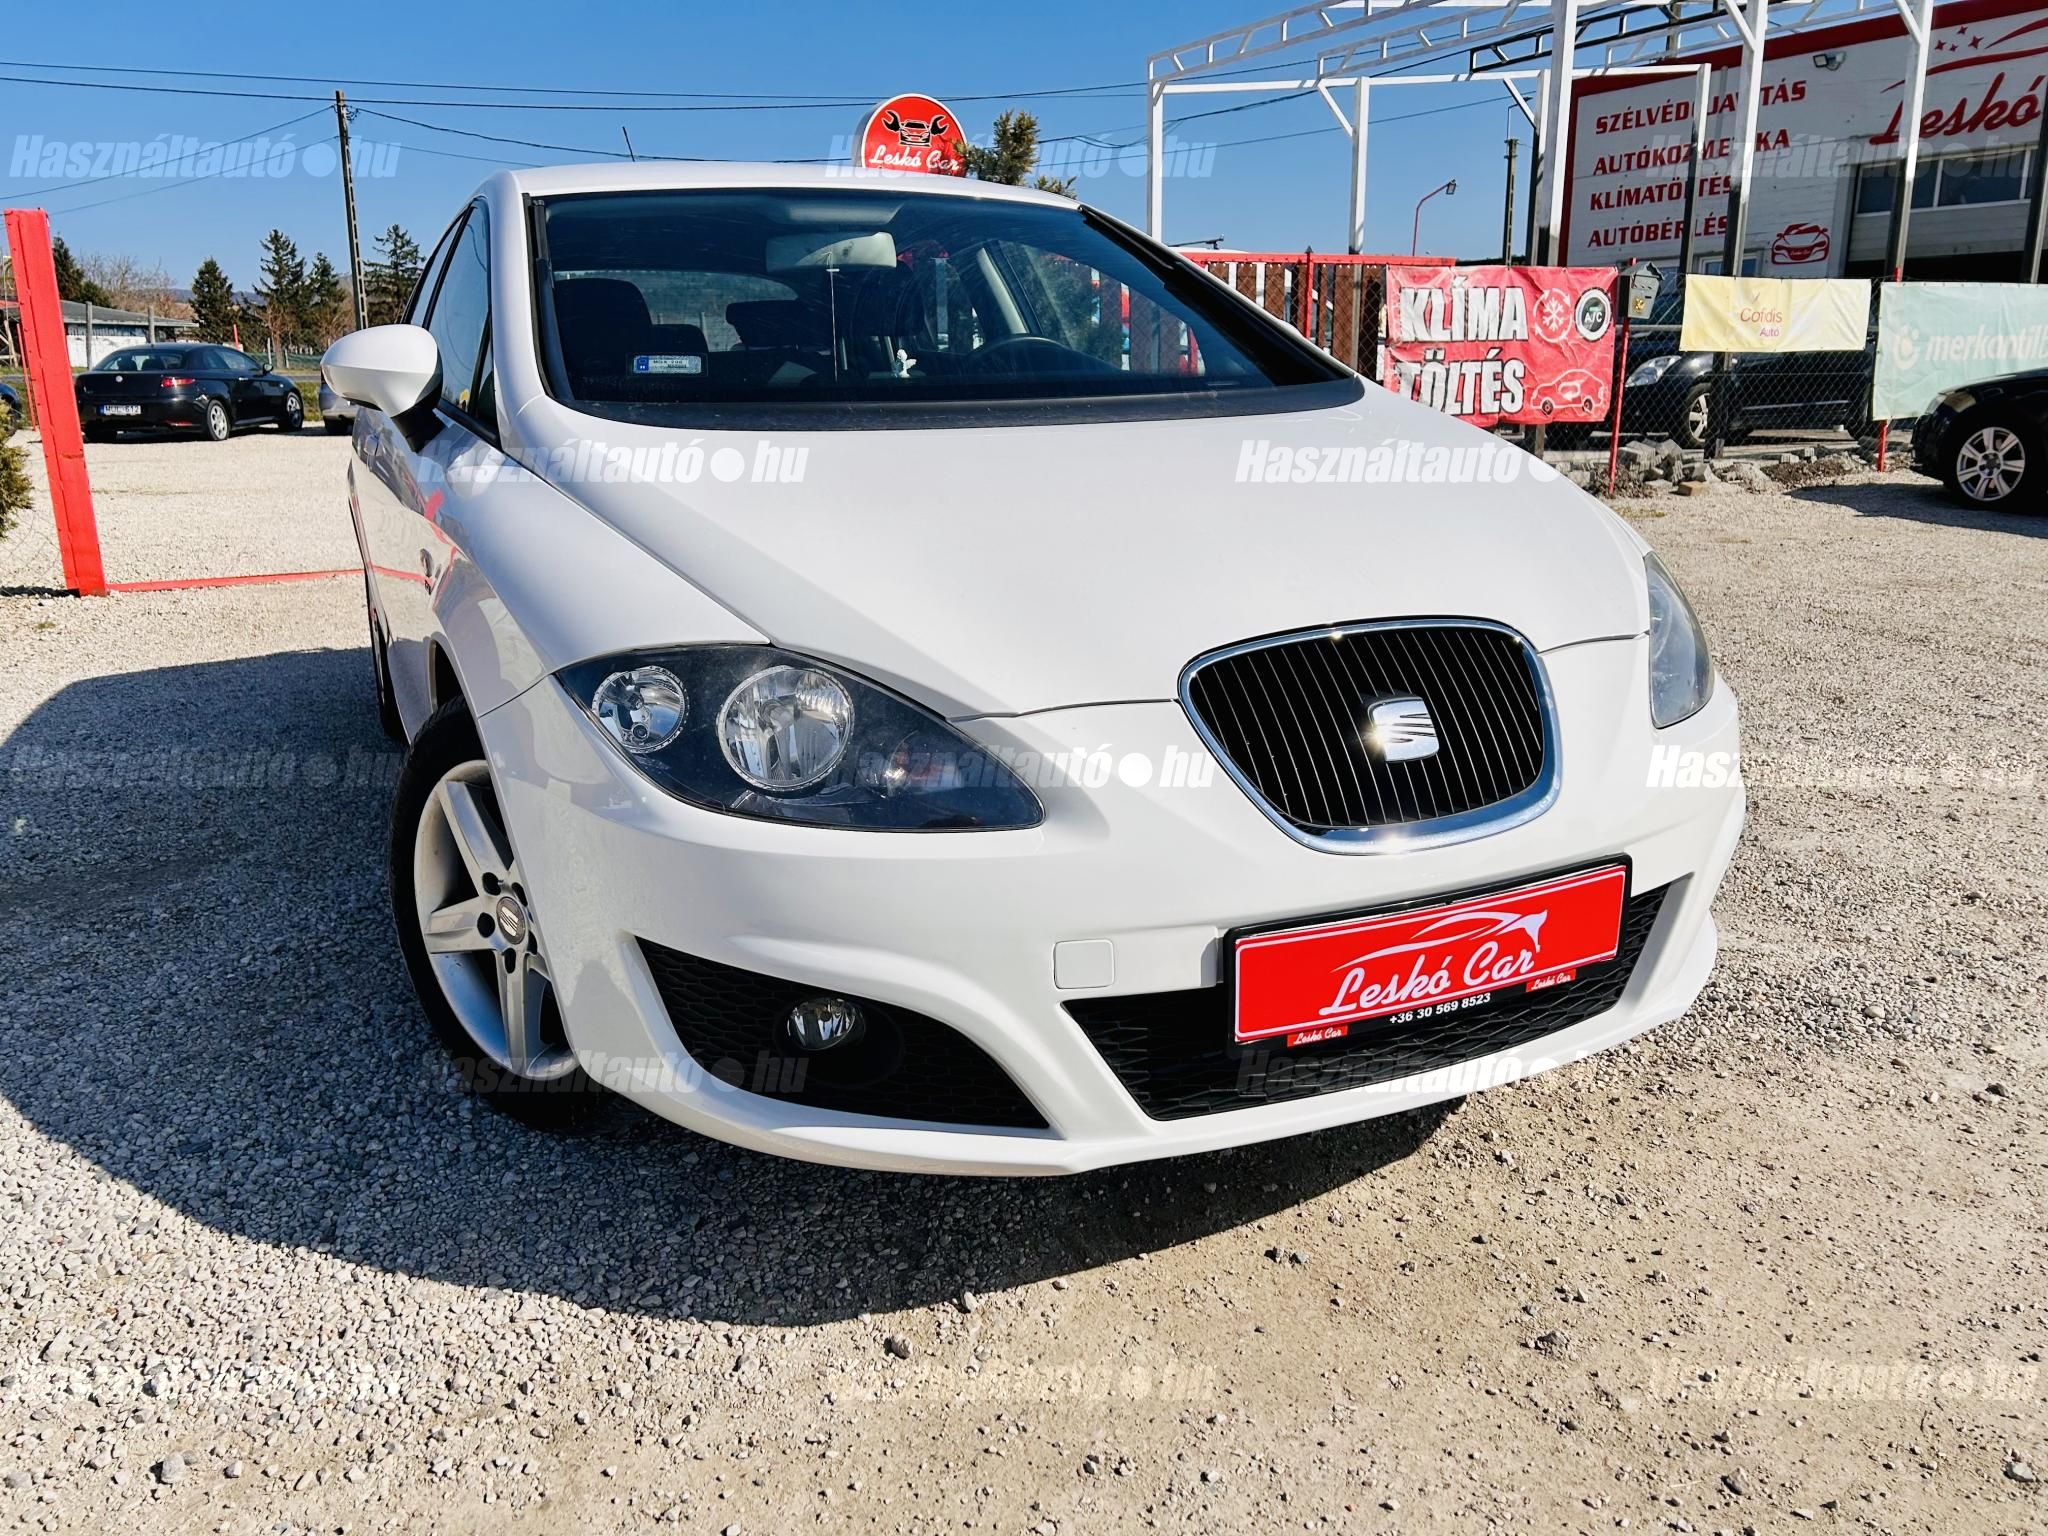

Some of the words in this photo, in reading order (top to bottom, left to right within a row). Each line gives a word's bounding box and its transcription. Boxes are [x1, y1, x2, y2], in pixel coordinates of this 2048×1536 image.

[869, 144, 922, 167] Leskó
[926, 149, 960, 171] Car
[1593, 128, 1790, 176] AUTÓKOZMEKA
[1400, 275, 1529, 342] KLÍMA
[1584, 311, 1603, 323] A/C
[1740, 306, 1783, 323] Cofidis
[1759, 327, 1780, 337] Autó
[1396, 347, 1526, 415] TÖLTÉS
[1319, 954, 1453, 1016] Leskó
[1463, 941, 1534, 986] Car
[1530, 977, 1556, 990] Leskó
[1556, 973, 1573, 984] Car
[1389, 1011, 1413, 1024] +36
[1417, 1007, 1432, 1019] 30
[1435, 1000, 1459, 1015] 569
[1461, 992, 1491, 1009] 8523
[1294, 1030, 1322, 1045] Leskó
[1324, 1027, 1342, 1039] Car
